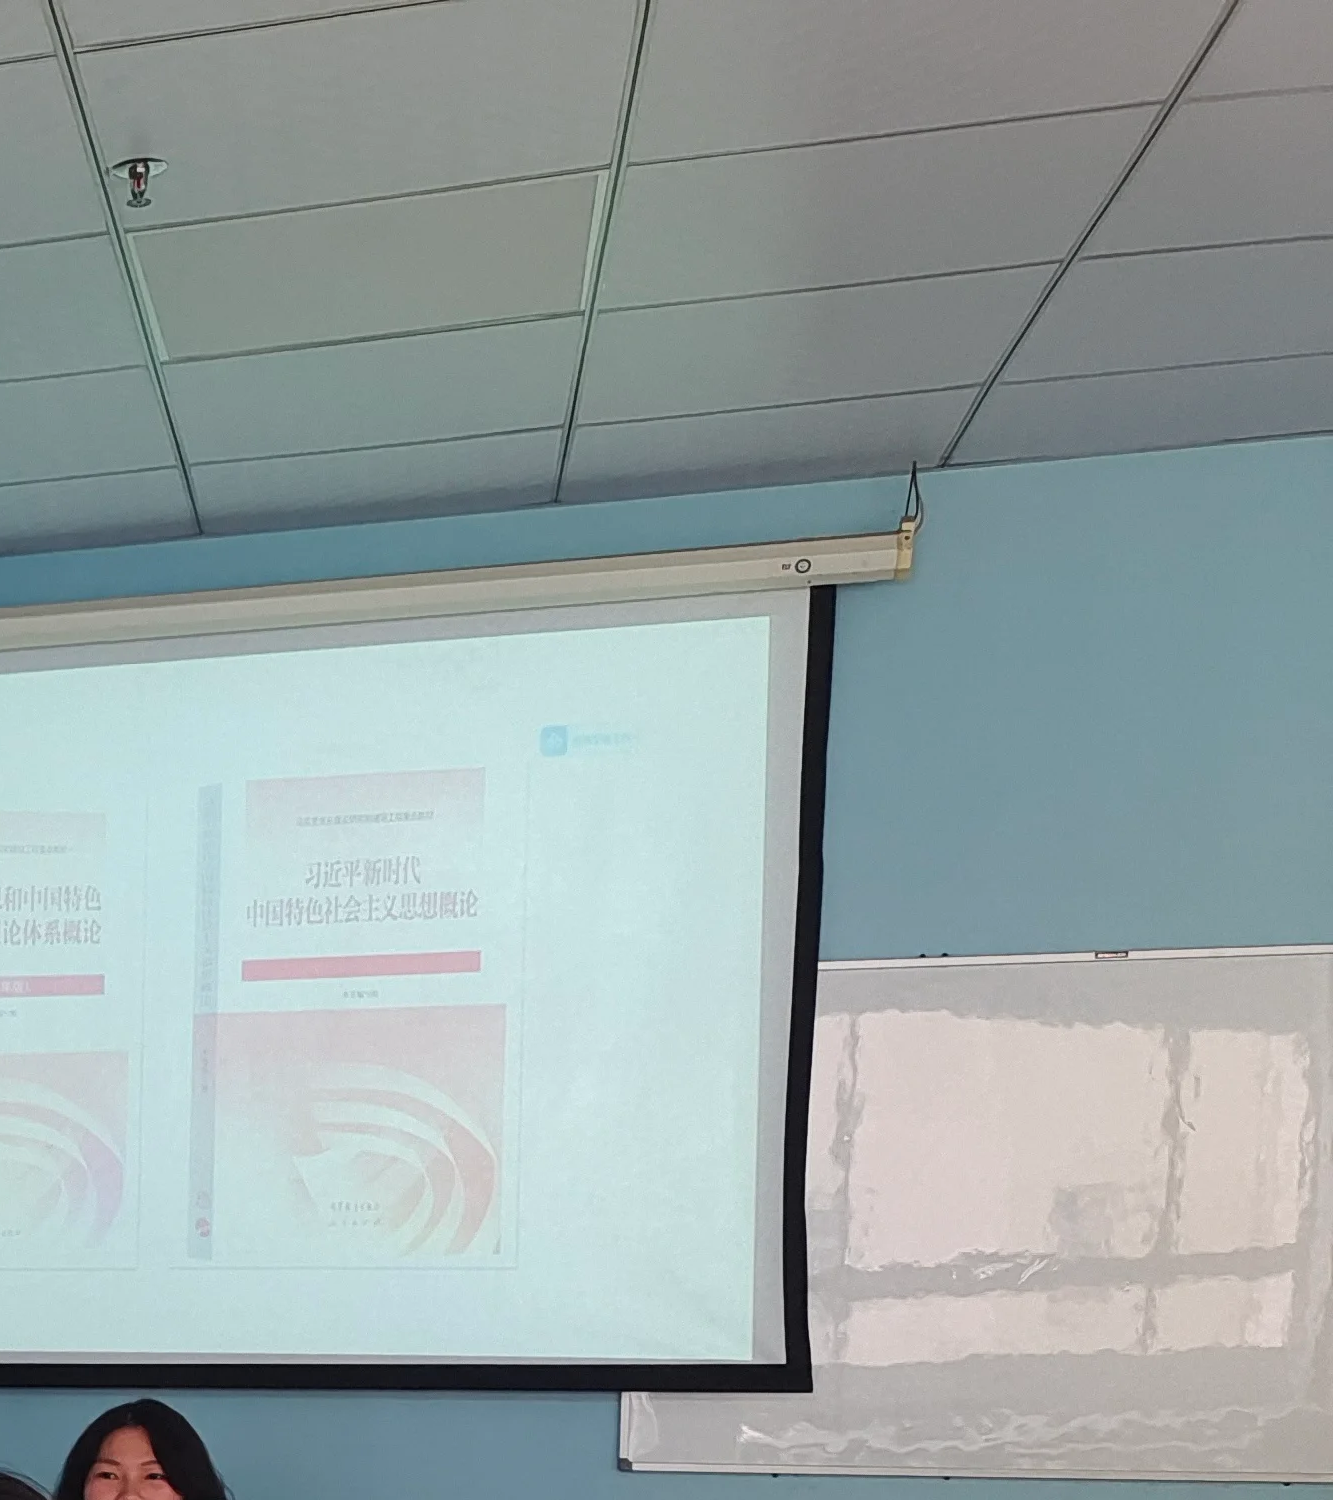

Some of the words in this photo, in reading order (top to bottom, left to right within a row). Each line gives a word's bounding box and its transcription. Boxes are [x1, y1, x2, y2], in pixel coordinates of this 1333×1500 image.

[305, 856, 421, 888] 习近平新时代
[245, 890, 479, 927] 中国特色社会主义思想概论
